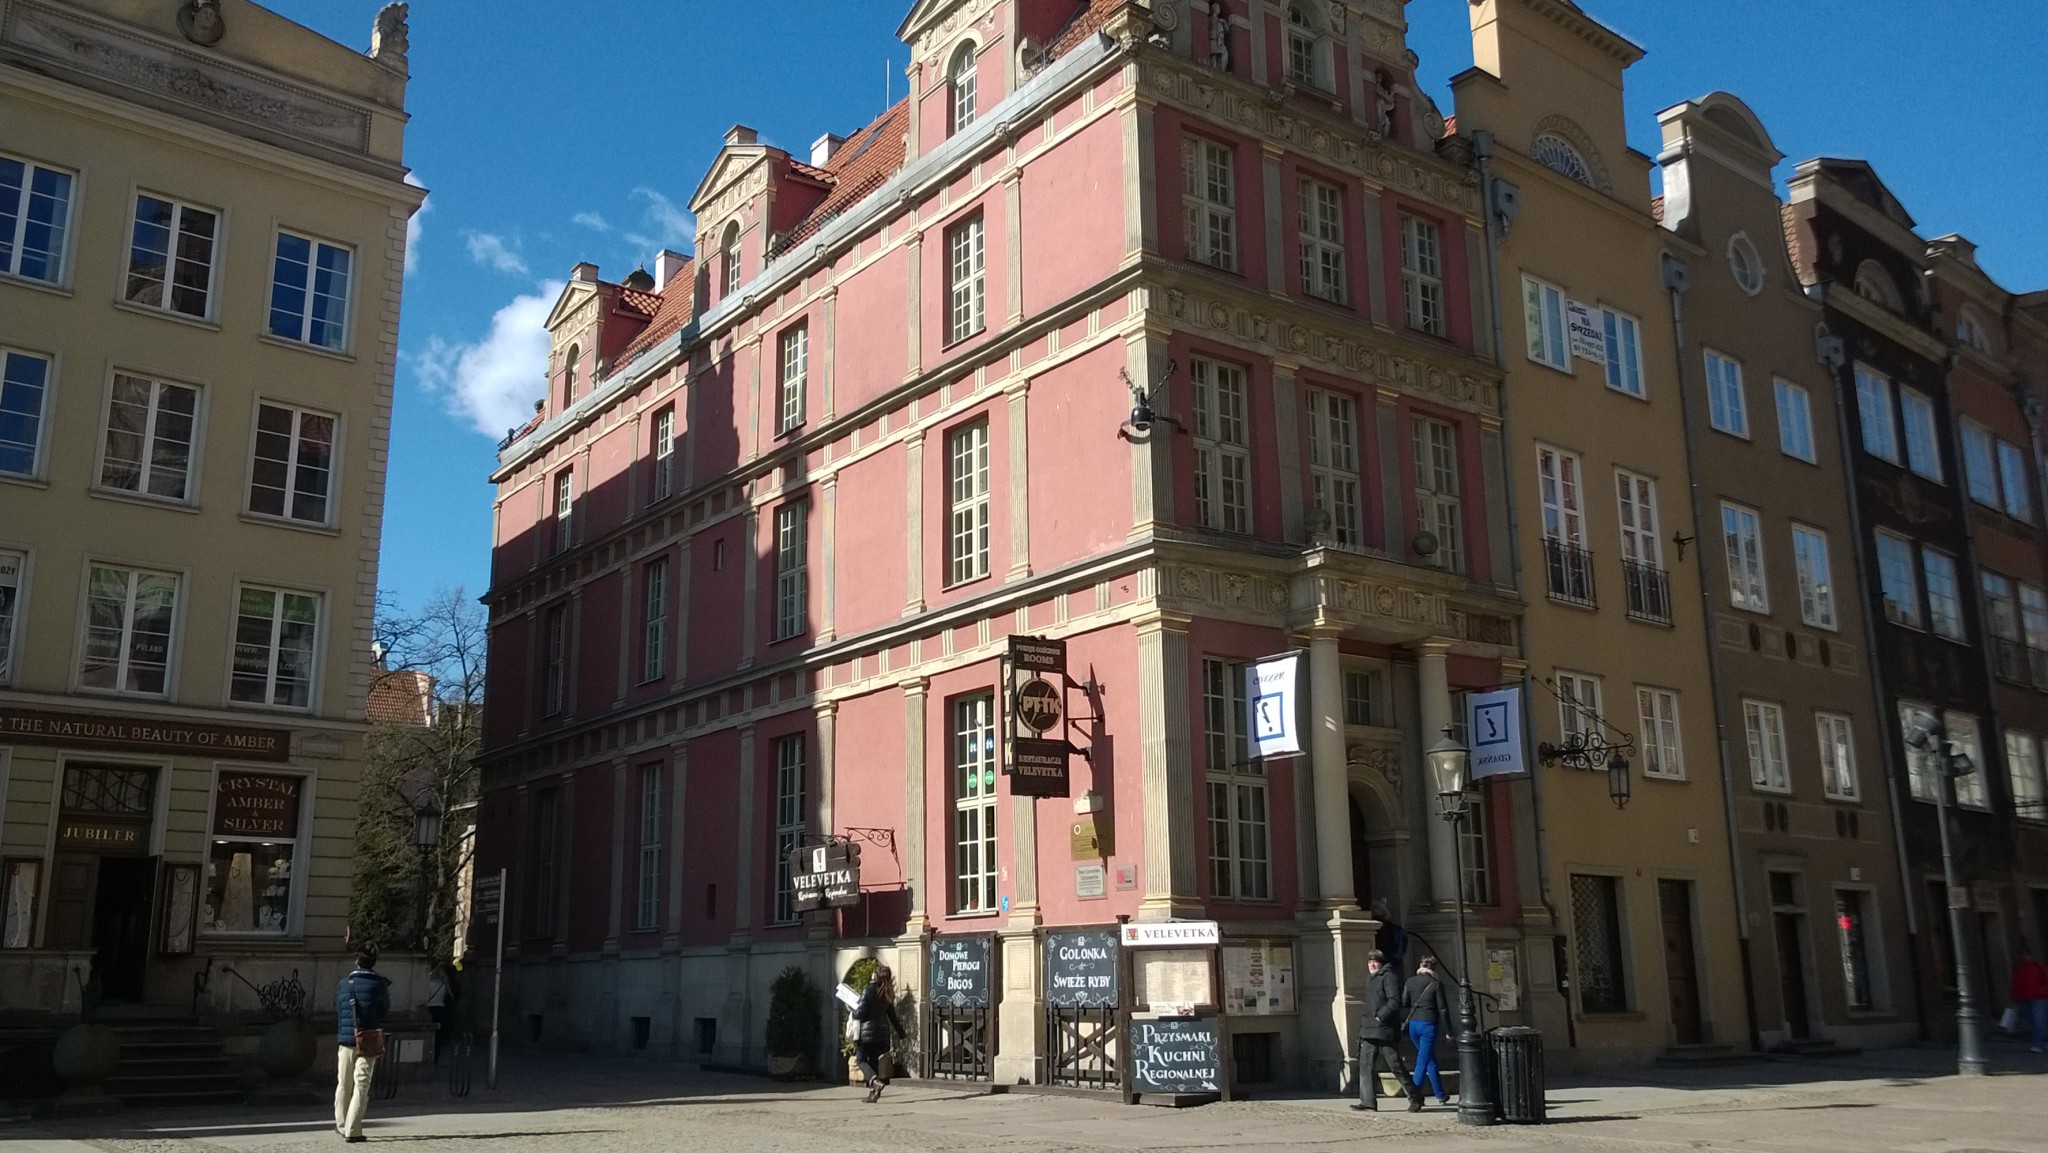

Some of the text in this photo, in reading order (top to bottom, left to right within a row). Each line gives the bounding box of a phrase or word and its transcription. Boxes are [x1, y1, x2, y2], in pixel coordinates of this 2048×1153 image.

[1024, 653, 1054, 665] ROOMS
[1003, 663, 1013, 766] PTTK
[9, 717, 43, 732] THE
[49, 721, 127, 739] NATURAL
[131, 727, 194, 744] BEAUTY
[198, 732, 218, 745] OF
[222, 735, 276, 750] AMBER
[1018, 755, 1063, 765] RESTAURACJA
[1018, 766, 1064, 778] VELEVETKA
[218, 777, 298, 798] CRYSTAL
[227, 797, 286, 810] AMBER
[224, 818, 284, 832] SILVER
[63, 827, 136, 842] JUBILER
[793, 870, 852, 890] VELEVETKA
[1144, 928, 1216, 939] VELEVETKA
[938, 949, 969, 962] DOMOWE
[1060, 946, 1107, 961] GOLONKA
[952, 959, 980, 972] PIEROGI
[947, 976, 973, 990] BIGOS
[1053, 972, 1111, 988] ŚWIEŻE RYBY
[1141, 1024, 1211, 1044] PRZYSMAKI
[1148, 1045, 1207, 1067] KUCHNI
[1135, 1059, 1216, 1085] REGIONALNEJ
